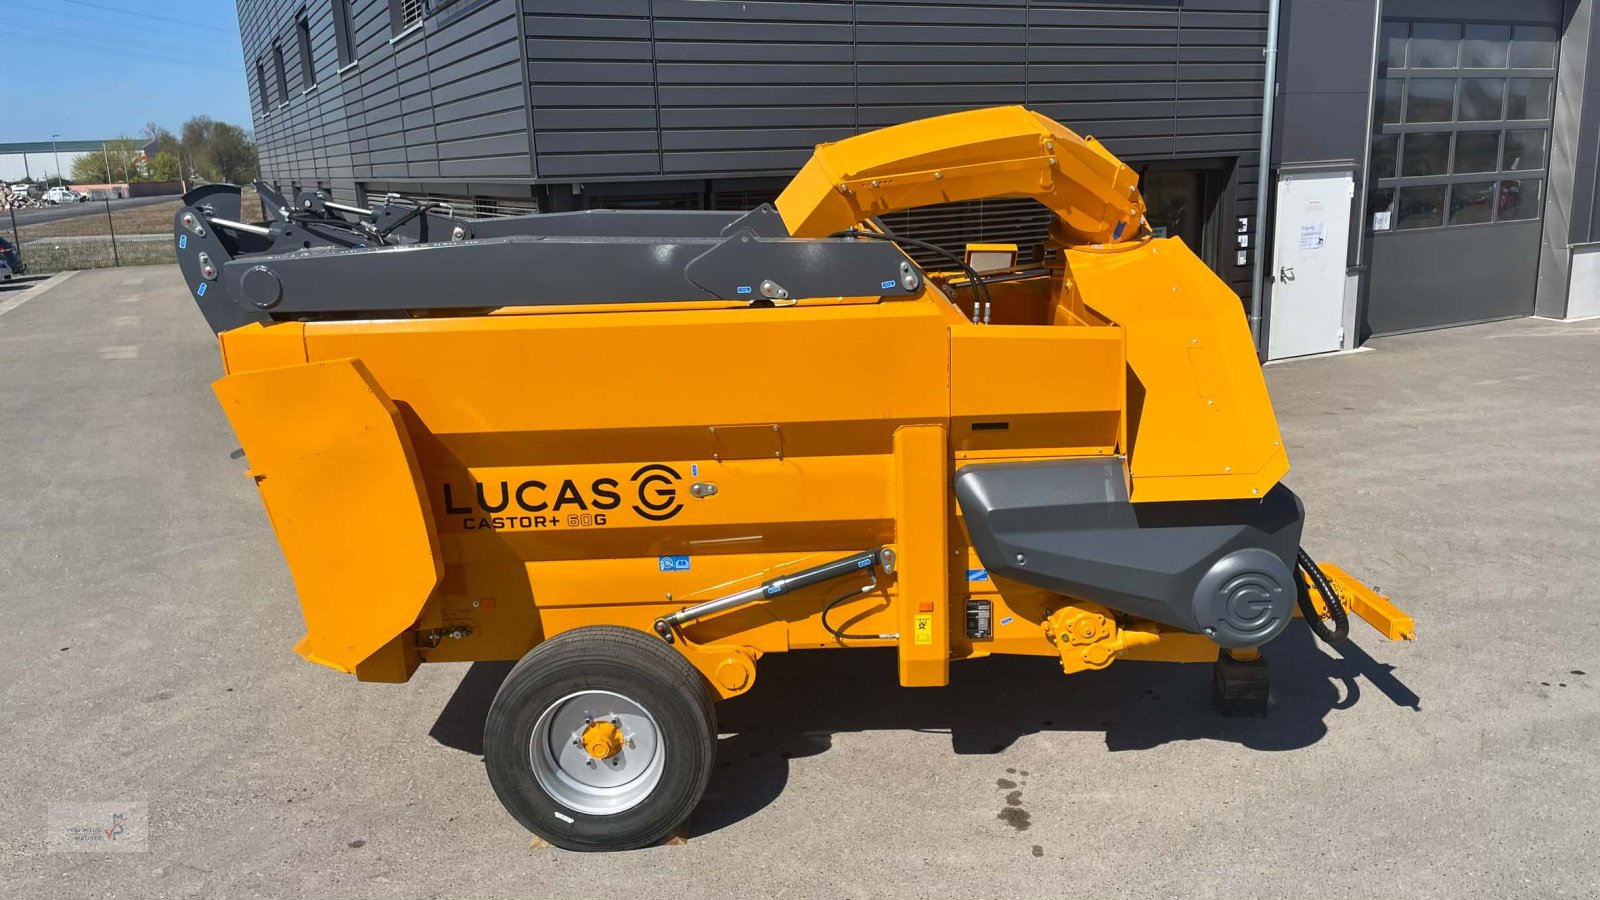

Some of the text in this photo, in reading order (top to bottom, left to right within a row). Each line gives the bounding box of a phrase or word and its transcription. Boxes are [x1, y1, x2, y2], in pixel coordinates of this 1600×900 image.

[444, 477, 622, 515] LUCAS
[463, 513, 607, 530] CASTOR+ 60G
